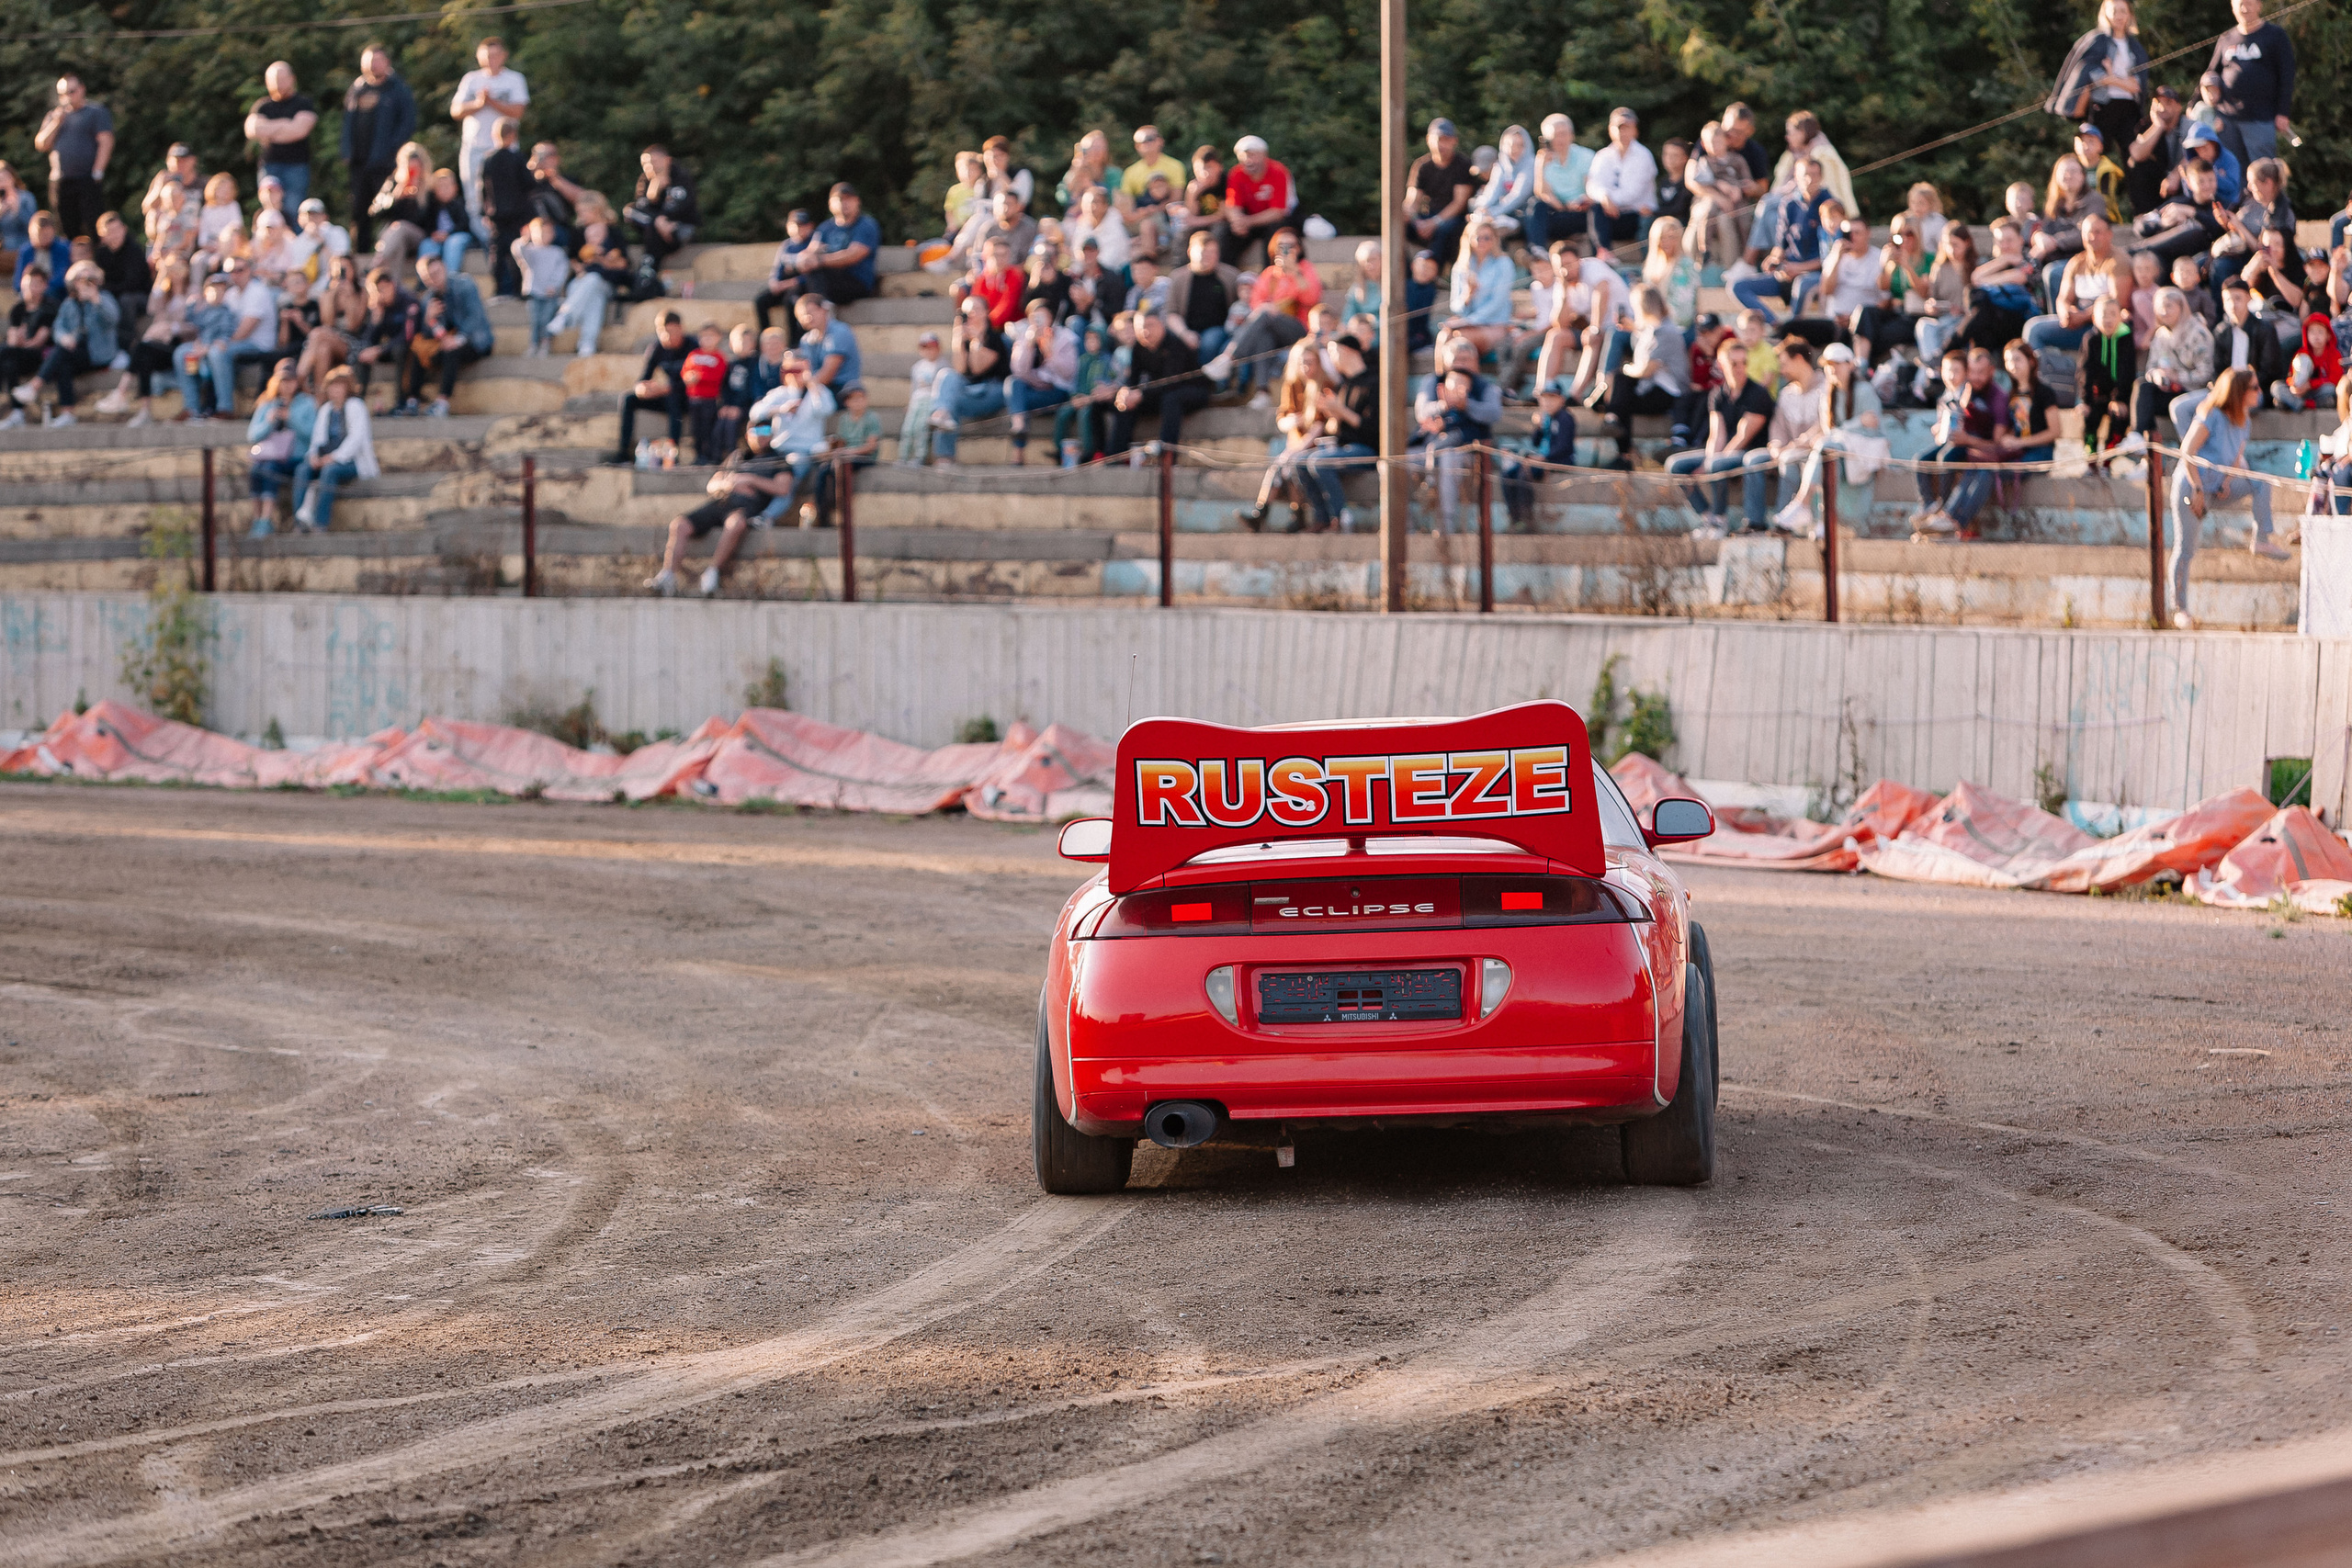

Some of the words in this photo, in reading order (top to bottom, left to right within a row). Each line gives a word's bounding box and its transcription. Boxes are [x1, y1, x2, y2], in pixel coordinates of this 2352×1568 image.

[1134, 743, 1572, 829] RUSTEZE
[1279, 903, 1434, 917] ECLIPSE
[1341, 1012, 1379, 1021] MITSUBISHI
